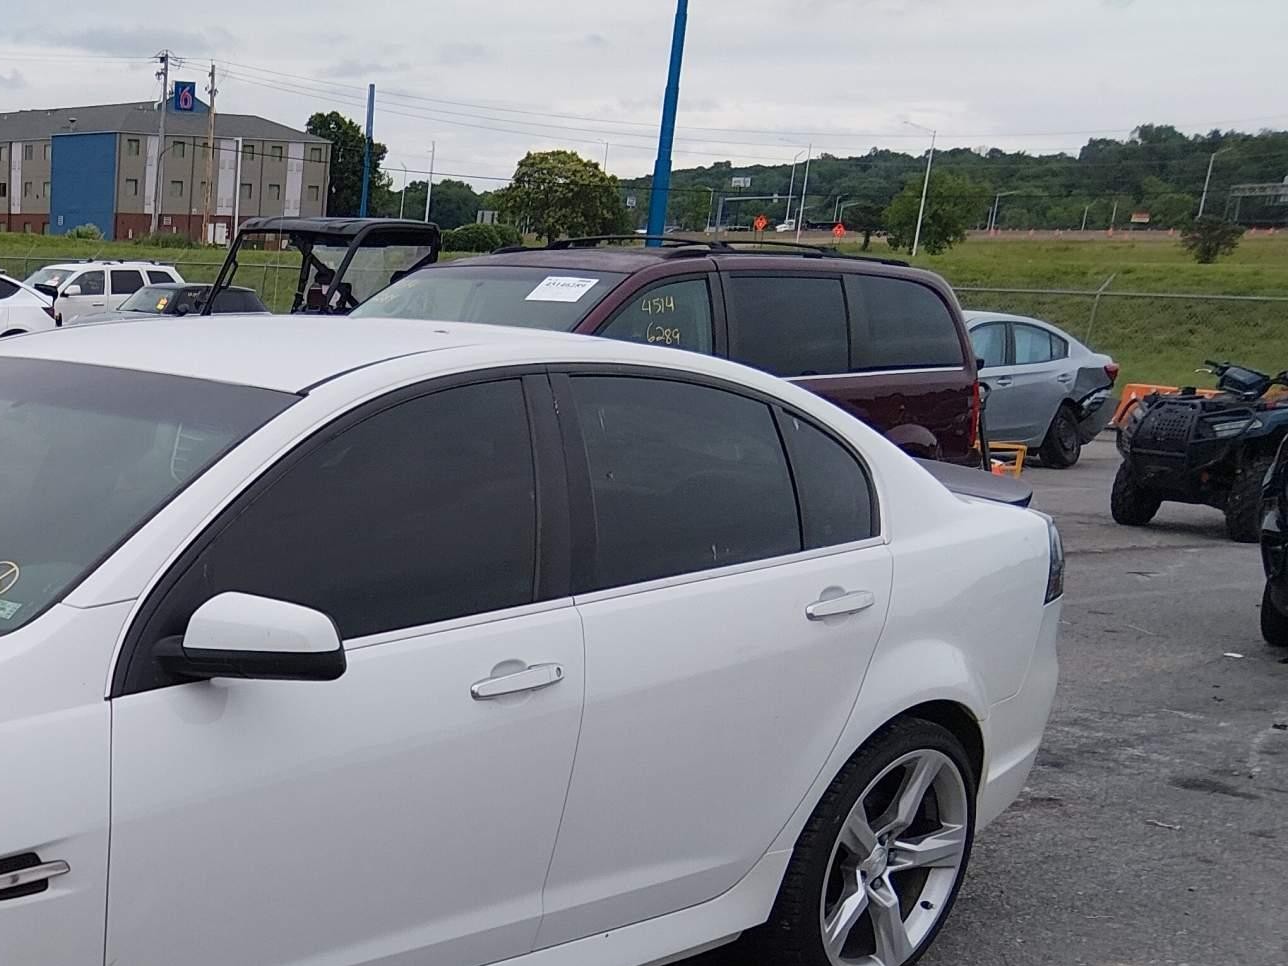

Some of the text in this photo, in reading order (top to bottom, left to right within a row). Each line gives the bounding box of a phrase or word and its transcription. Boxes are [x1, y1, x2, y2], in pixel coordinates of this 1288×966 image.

[179, 86, 192, 109] 6
[641, 296, 675, 315] 4514
[646, 320, 680, 345] 6289
